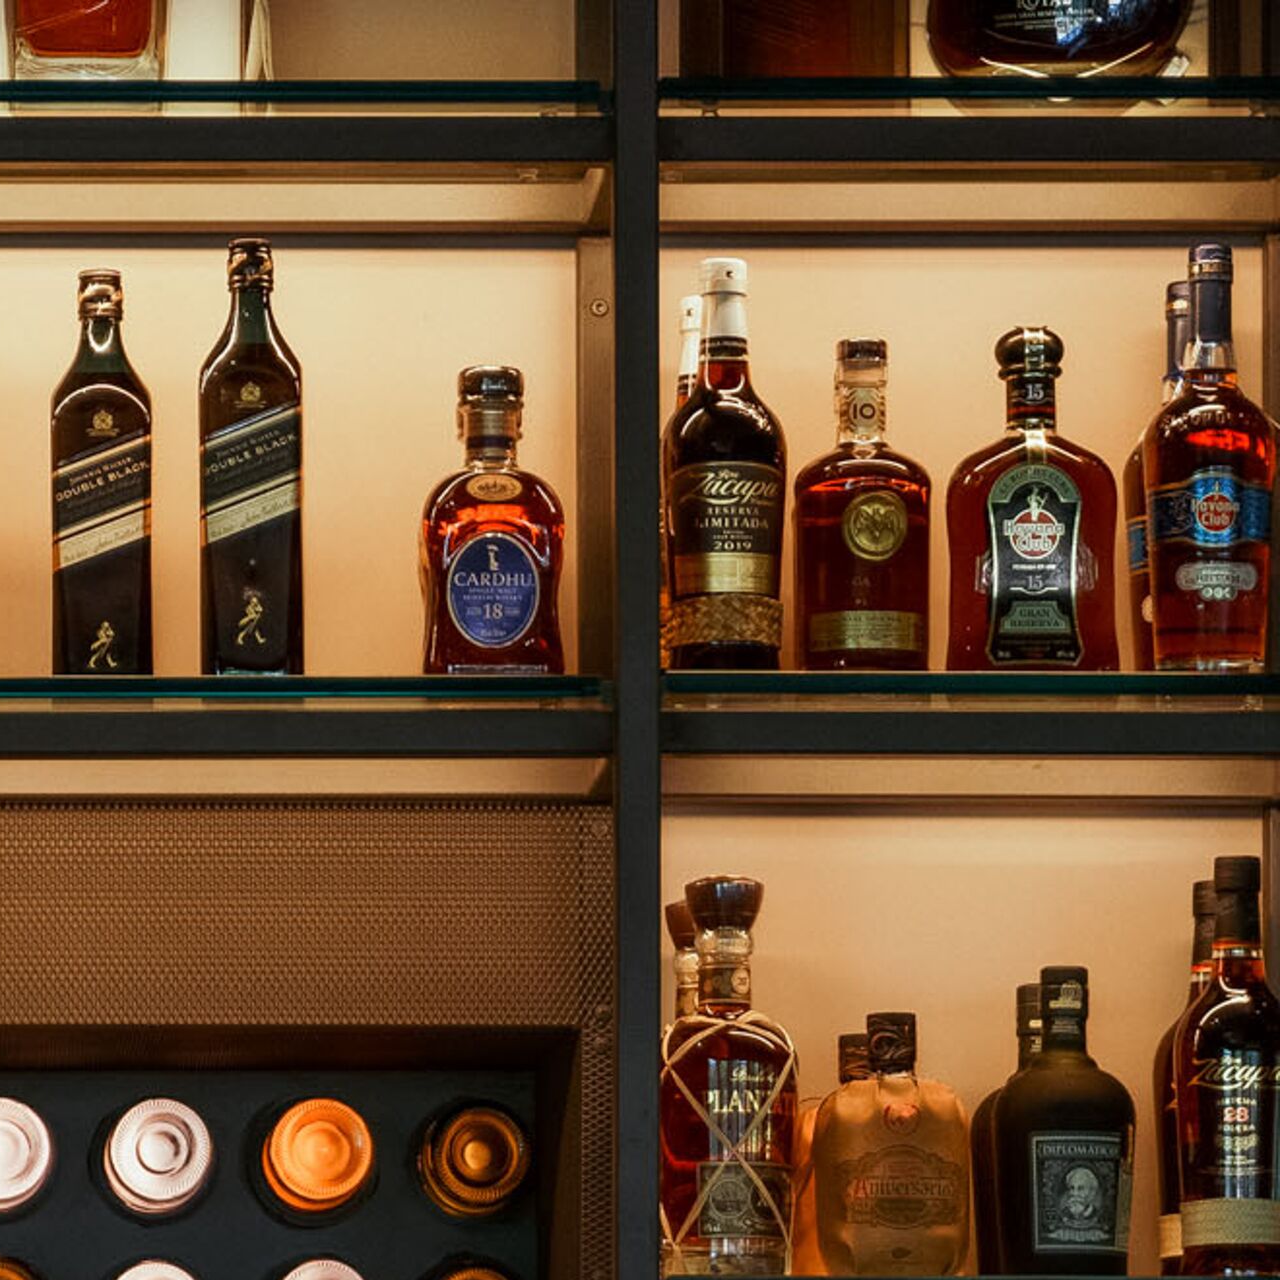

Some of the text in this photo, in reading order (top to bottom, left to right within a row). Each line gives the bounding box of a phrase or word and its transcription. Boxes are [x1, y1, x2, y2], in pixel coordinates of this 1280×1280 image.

[1026, 383, 1044, 400] 15
[853, 403, 876, 420] 10
[255, 433, 295, 455] BLACK
[56, 461, 147, 502] DOUBLE BLACK
[688, 472, 778, 505] Zacapa
[707, 507, 760, 515] RESERVA
[1191, 498, 1240, 513] Havana
[695, 517, 768, 528] LIMITADA
[1003, 518, 1065, 536] Havana
[1201, 512, 1230, 526] Club
[713, 541, 752, 550] 2019
[1017, 532, 1052, 552] Club
[454, 571, 531, 587] CARDHU
[1026, 575, 1043, 590] 15
[483, 604, 503, 620] 18
